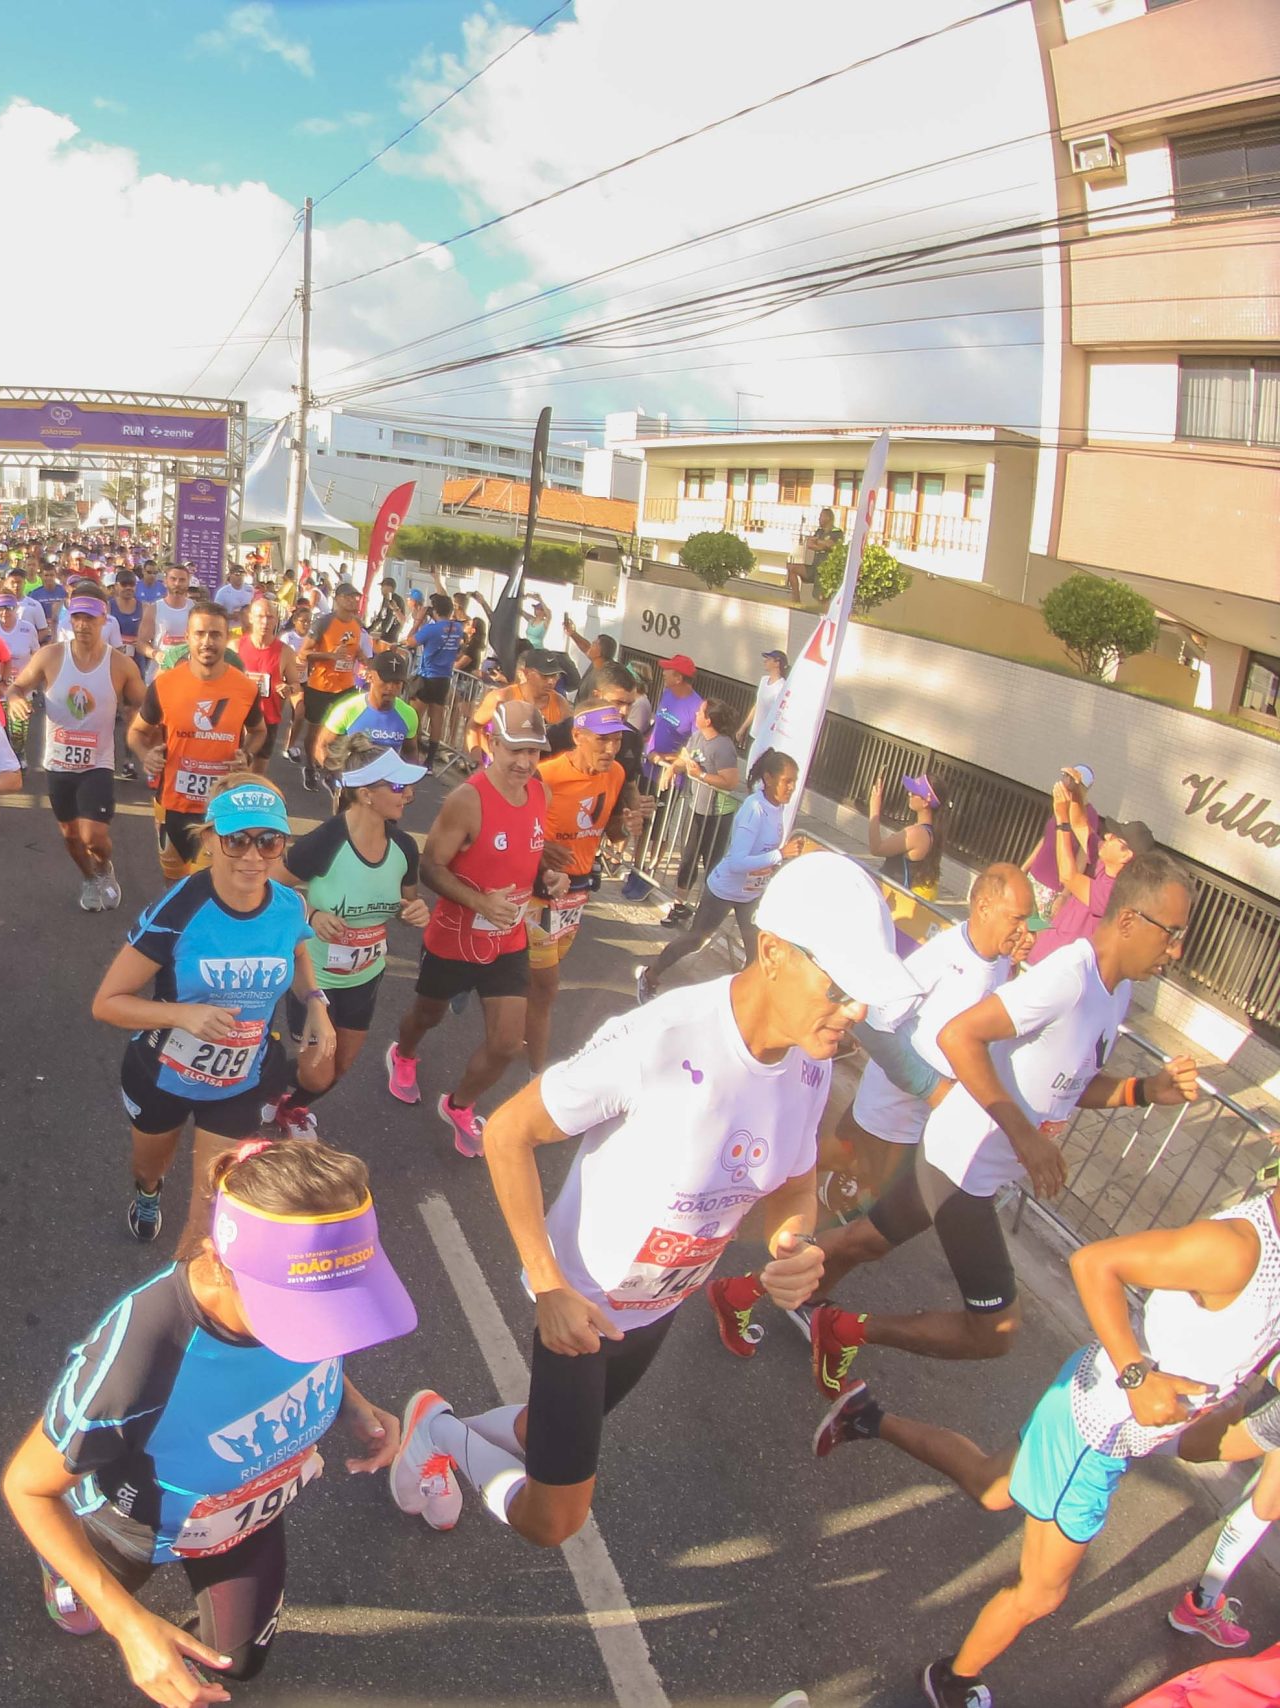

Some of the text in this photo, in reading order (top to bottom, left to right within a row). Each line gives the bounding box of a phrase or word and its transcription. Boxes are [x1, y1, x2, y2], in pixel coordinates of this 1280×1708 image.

[123, 425, 195, 438] RUN zenite
[641, 609, 681, 639] 908
[65, 746, 91, 764] 258
[1181, 773, 1280, 849] Villa
[222, 990, 275, 999] FISIOFITNESS
[190, 1043, 250, 1078] 209
[183, 1068, 224, 1088] ELOISA
[800, 1059, 824, 1090] RUN
[667, 1198, 716, 1214] JOÃO
[288, 1258, 334, 1276] JOÃO
[335, 1245, 375, 1269] PESSOA
[318, 1272, 335, 1281] HALF
[652, 1262, 711, 1299] 14
[241, 1405, 335, 1481] RN FISIOFITNESS
[182, 1530, 209, 1539] 21K
